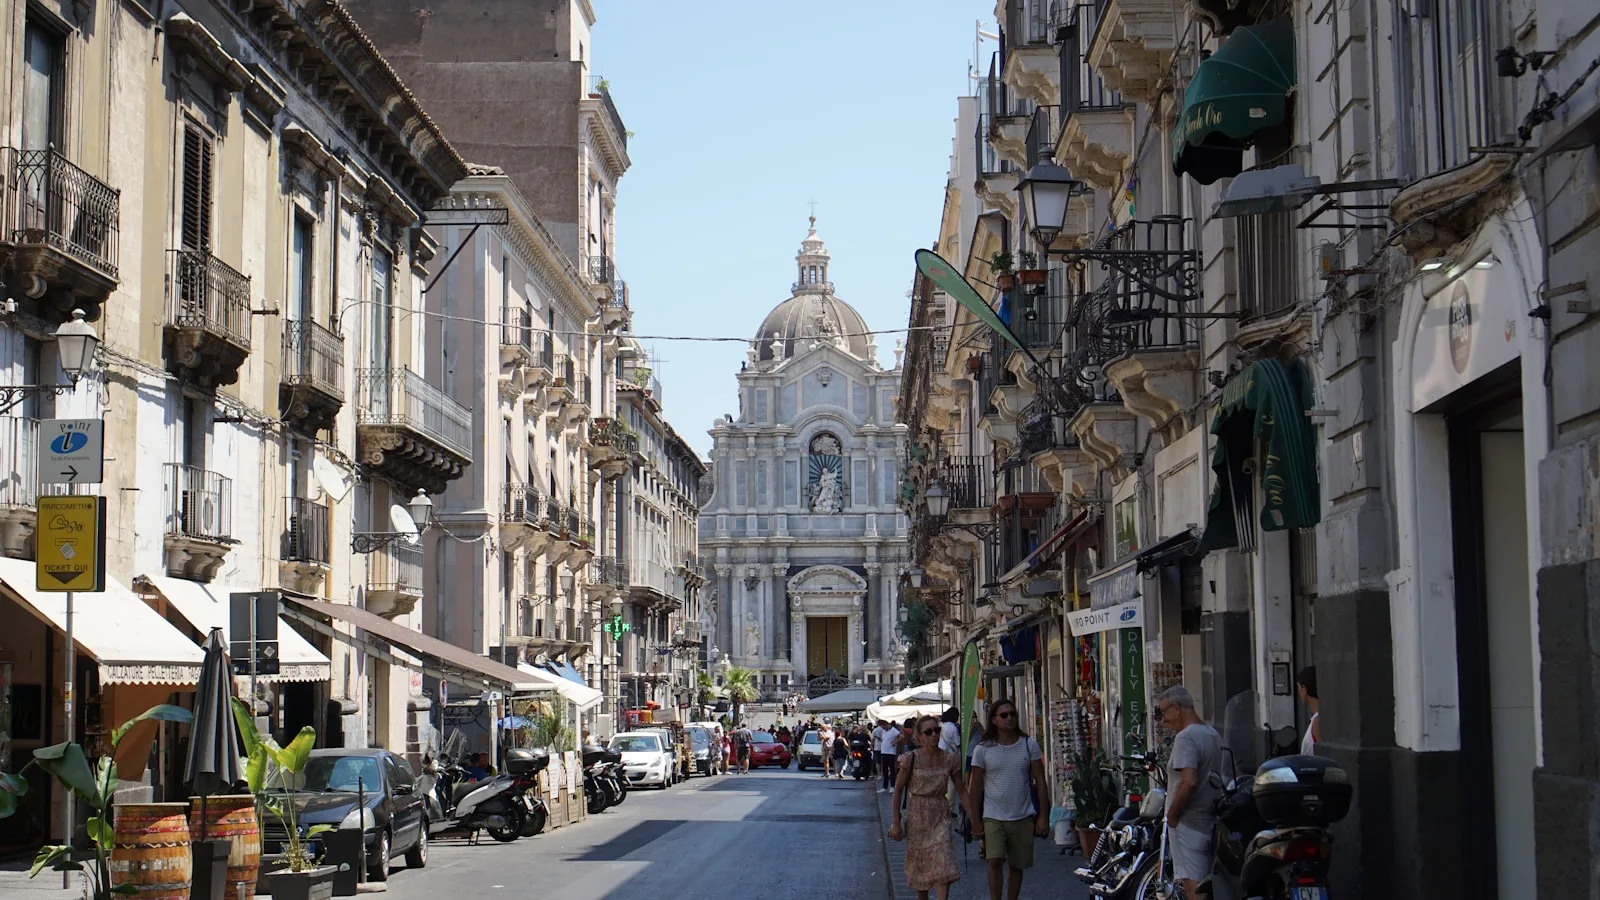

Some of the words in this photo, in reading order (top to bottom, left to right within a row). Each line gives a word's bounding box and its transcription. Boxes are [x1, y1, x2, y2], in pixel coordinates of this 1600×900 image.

[1085, 612, 1110, 625] POINT
[1128, 632, 1138, 690] DAILY
[108, 665, 143, 680] CALZATURE
[148, 665, 183, 680] PELLETTERIA
